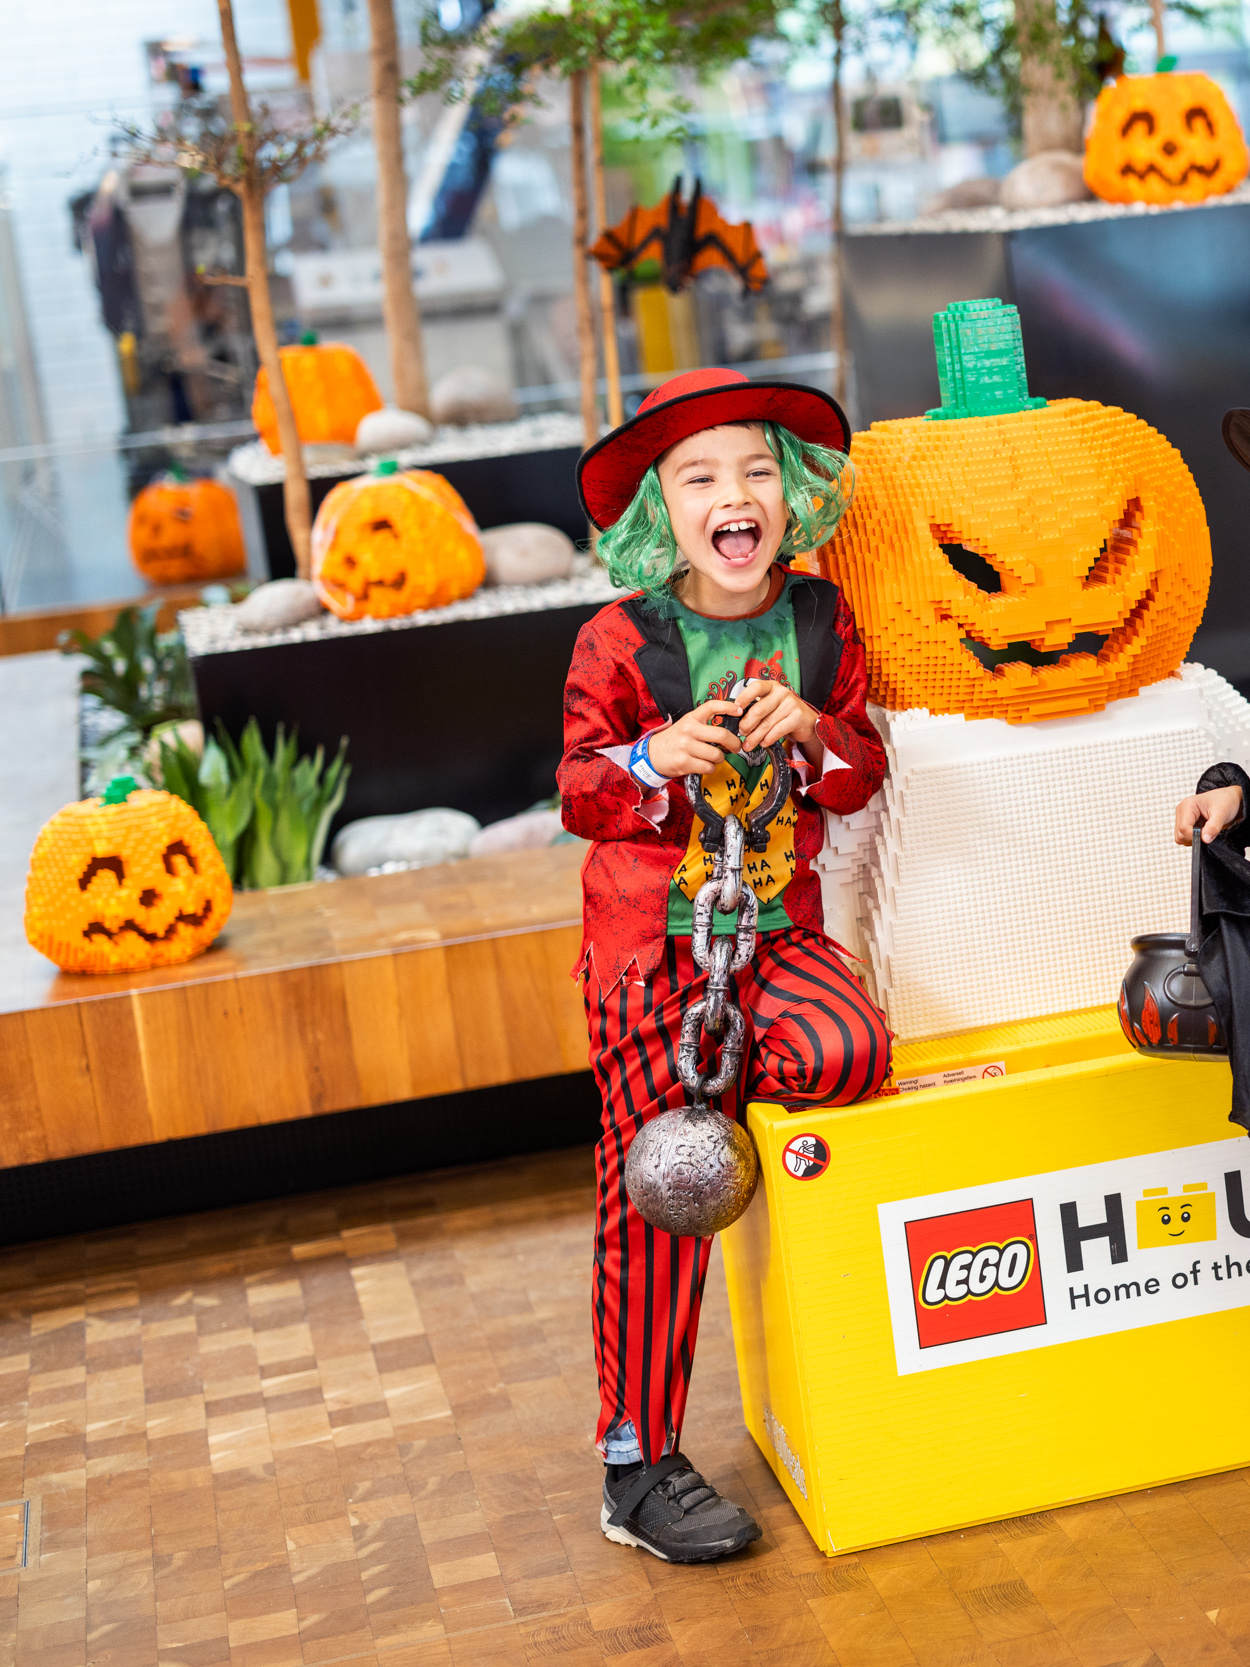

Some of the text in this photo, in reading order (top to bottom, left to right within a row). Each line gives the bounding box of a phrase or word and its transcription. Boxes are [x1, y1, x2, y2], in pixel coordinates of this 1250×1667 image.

[747, 859, 771, 874] HA
[753, 874, 775, 889] HA
[1069, 1278, 1160, 1310] Home
[1172, 1260, 1201, 1290] of
